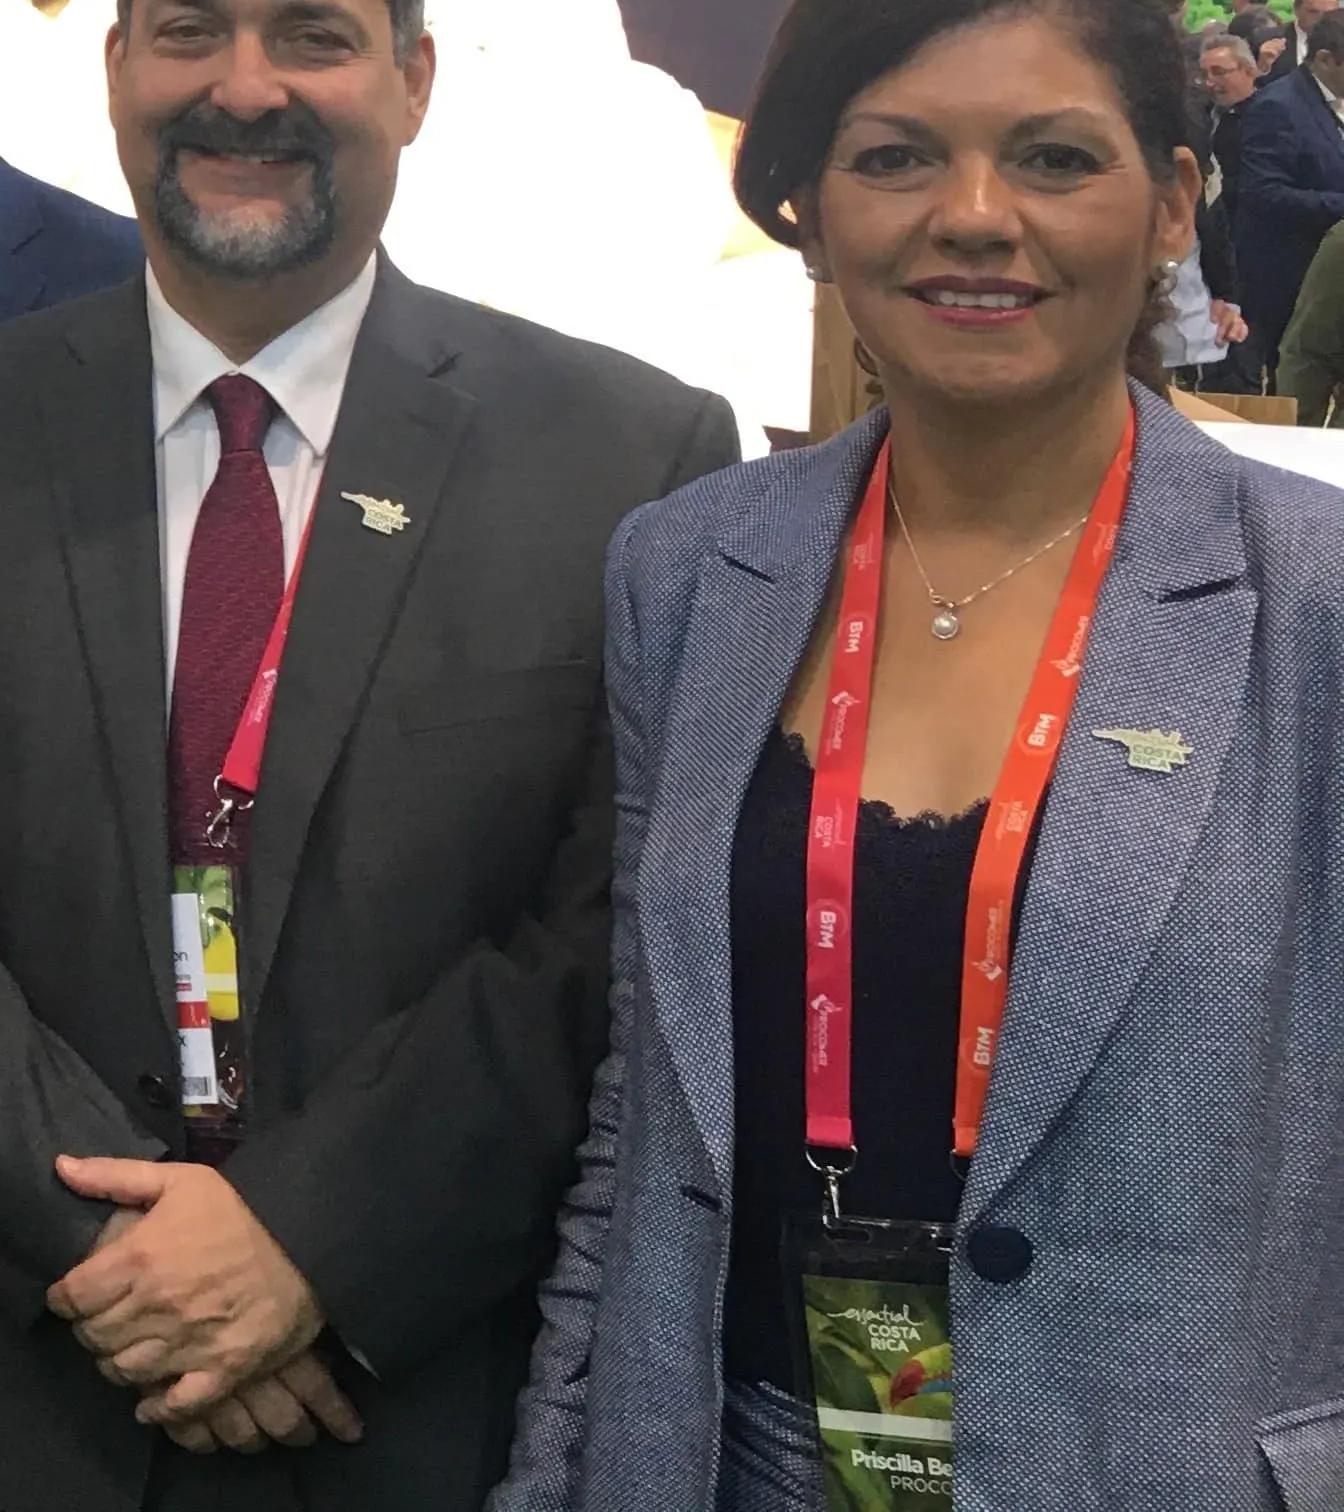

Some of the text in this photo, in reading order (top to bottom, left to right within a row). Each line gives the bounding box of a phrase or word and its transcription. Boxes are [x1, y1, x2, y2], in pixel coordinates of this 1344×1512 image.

[844, 620, 864, 653] BTM
[1027, 712, 1057, 747] BTM
[817, 910, 837, 949] BTM
[973, 1025, 995, 1066] BTM
[867, 1324, 922, 1341] COSTA
[870, 1338, 910, 1353] RICA
[850, 1448, 925, 1475] Priscilla
